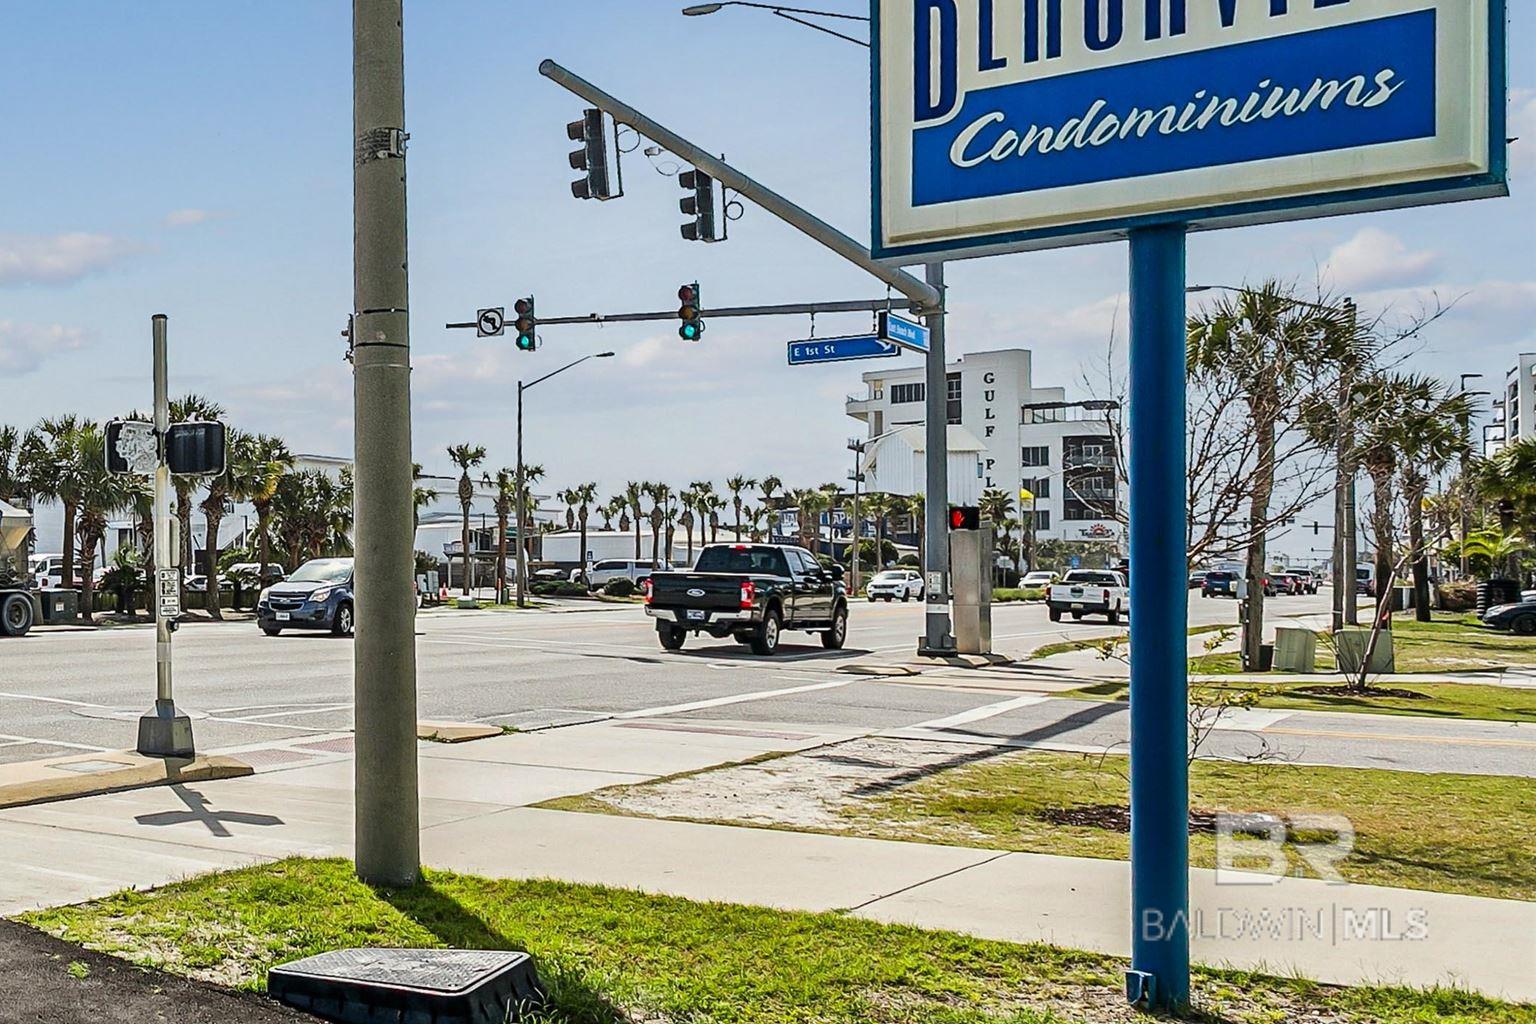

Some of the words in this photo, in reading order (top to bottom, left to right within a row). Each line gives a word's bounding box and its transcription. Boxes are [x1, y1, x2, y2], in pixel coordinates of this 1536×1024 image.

[949, 65, 1405, 169] Condominiums
[793, 347, 801, 357] E
[805, 346, 819, 356] 1st
[824, 344, 836, 355] St
[983, 372, 996, 438] GULF
